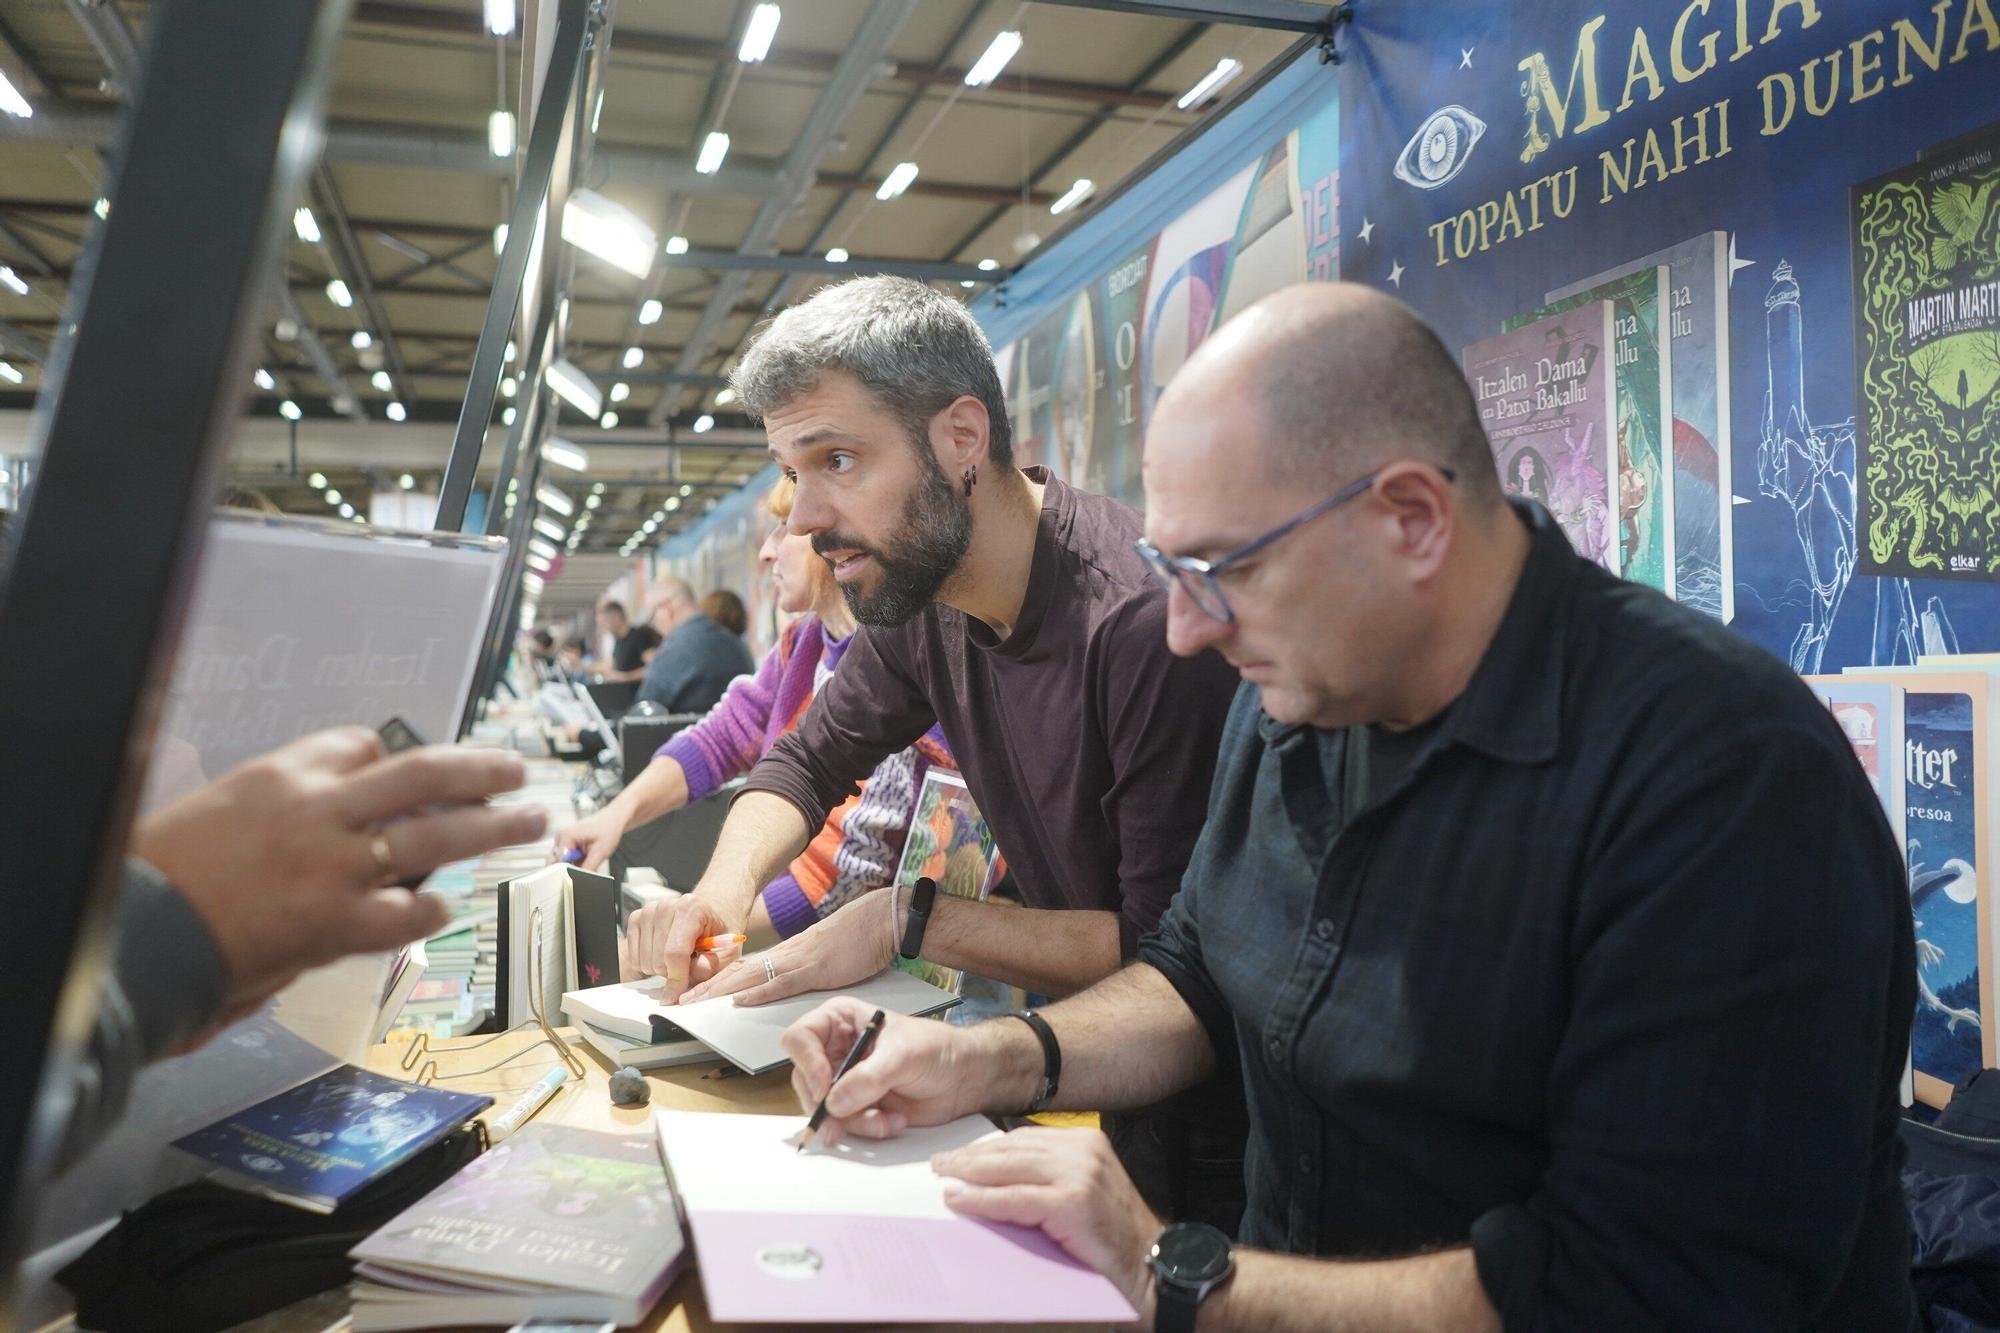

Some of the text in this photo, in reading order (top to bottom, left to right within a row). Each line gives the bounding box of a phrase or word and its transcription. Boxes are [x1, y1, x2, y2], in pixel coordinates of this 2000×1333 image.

[1428, 0, 2000, 267] TOPATU NAHI DUENA
[1908, 291, 1955, 340] MARTIN
[1476, 366, 1529, 401] Itzalen
[1534, 357, 1587, 388] Dama
[1535, 379, 1587, 411] Bakallu
[1950, 554, 1980, 568] elkar
